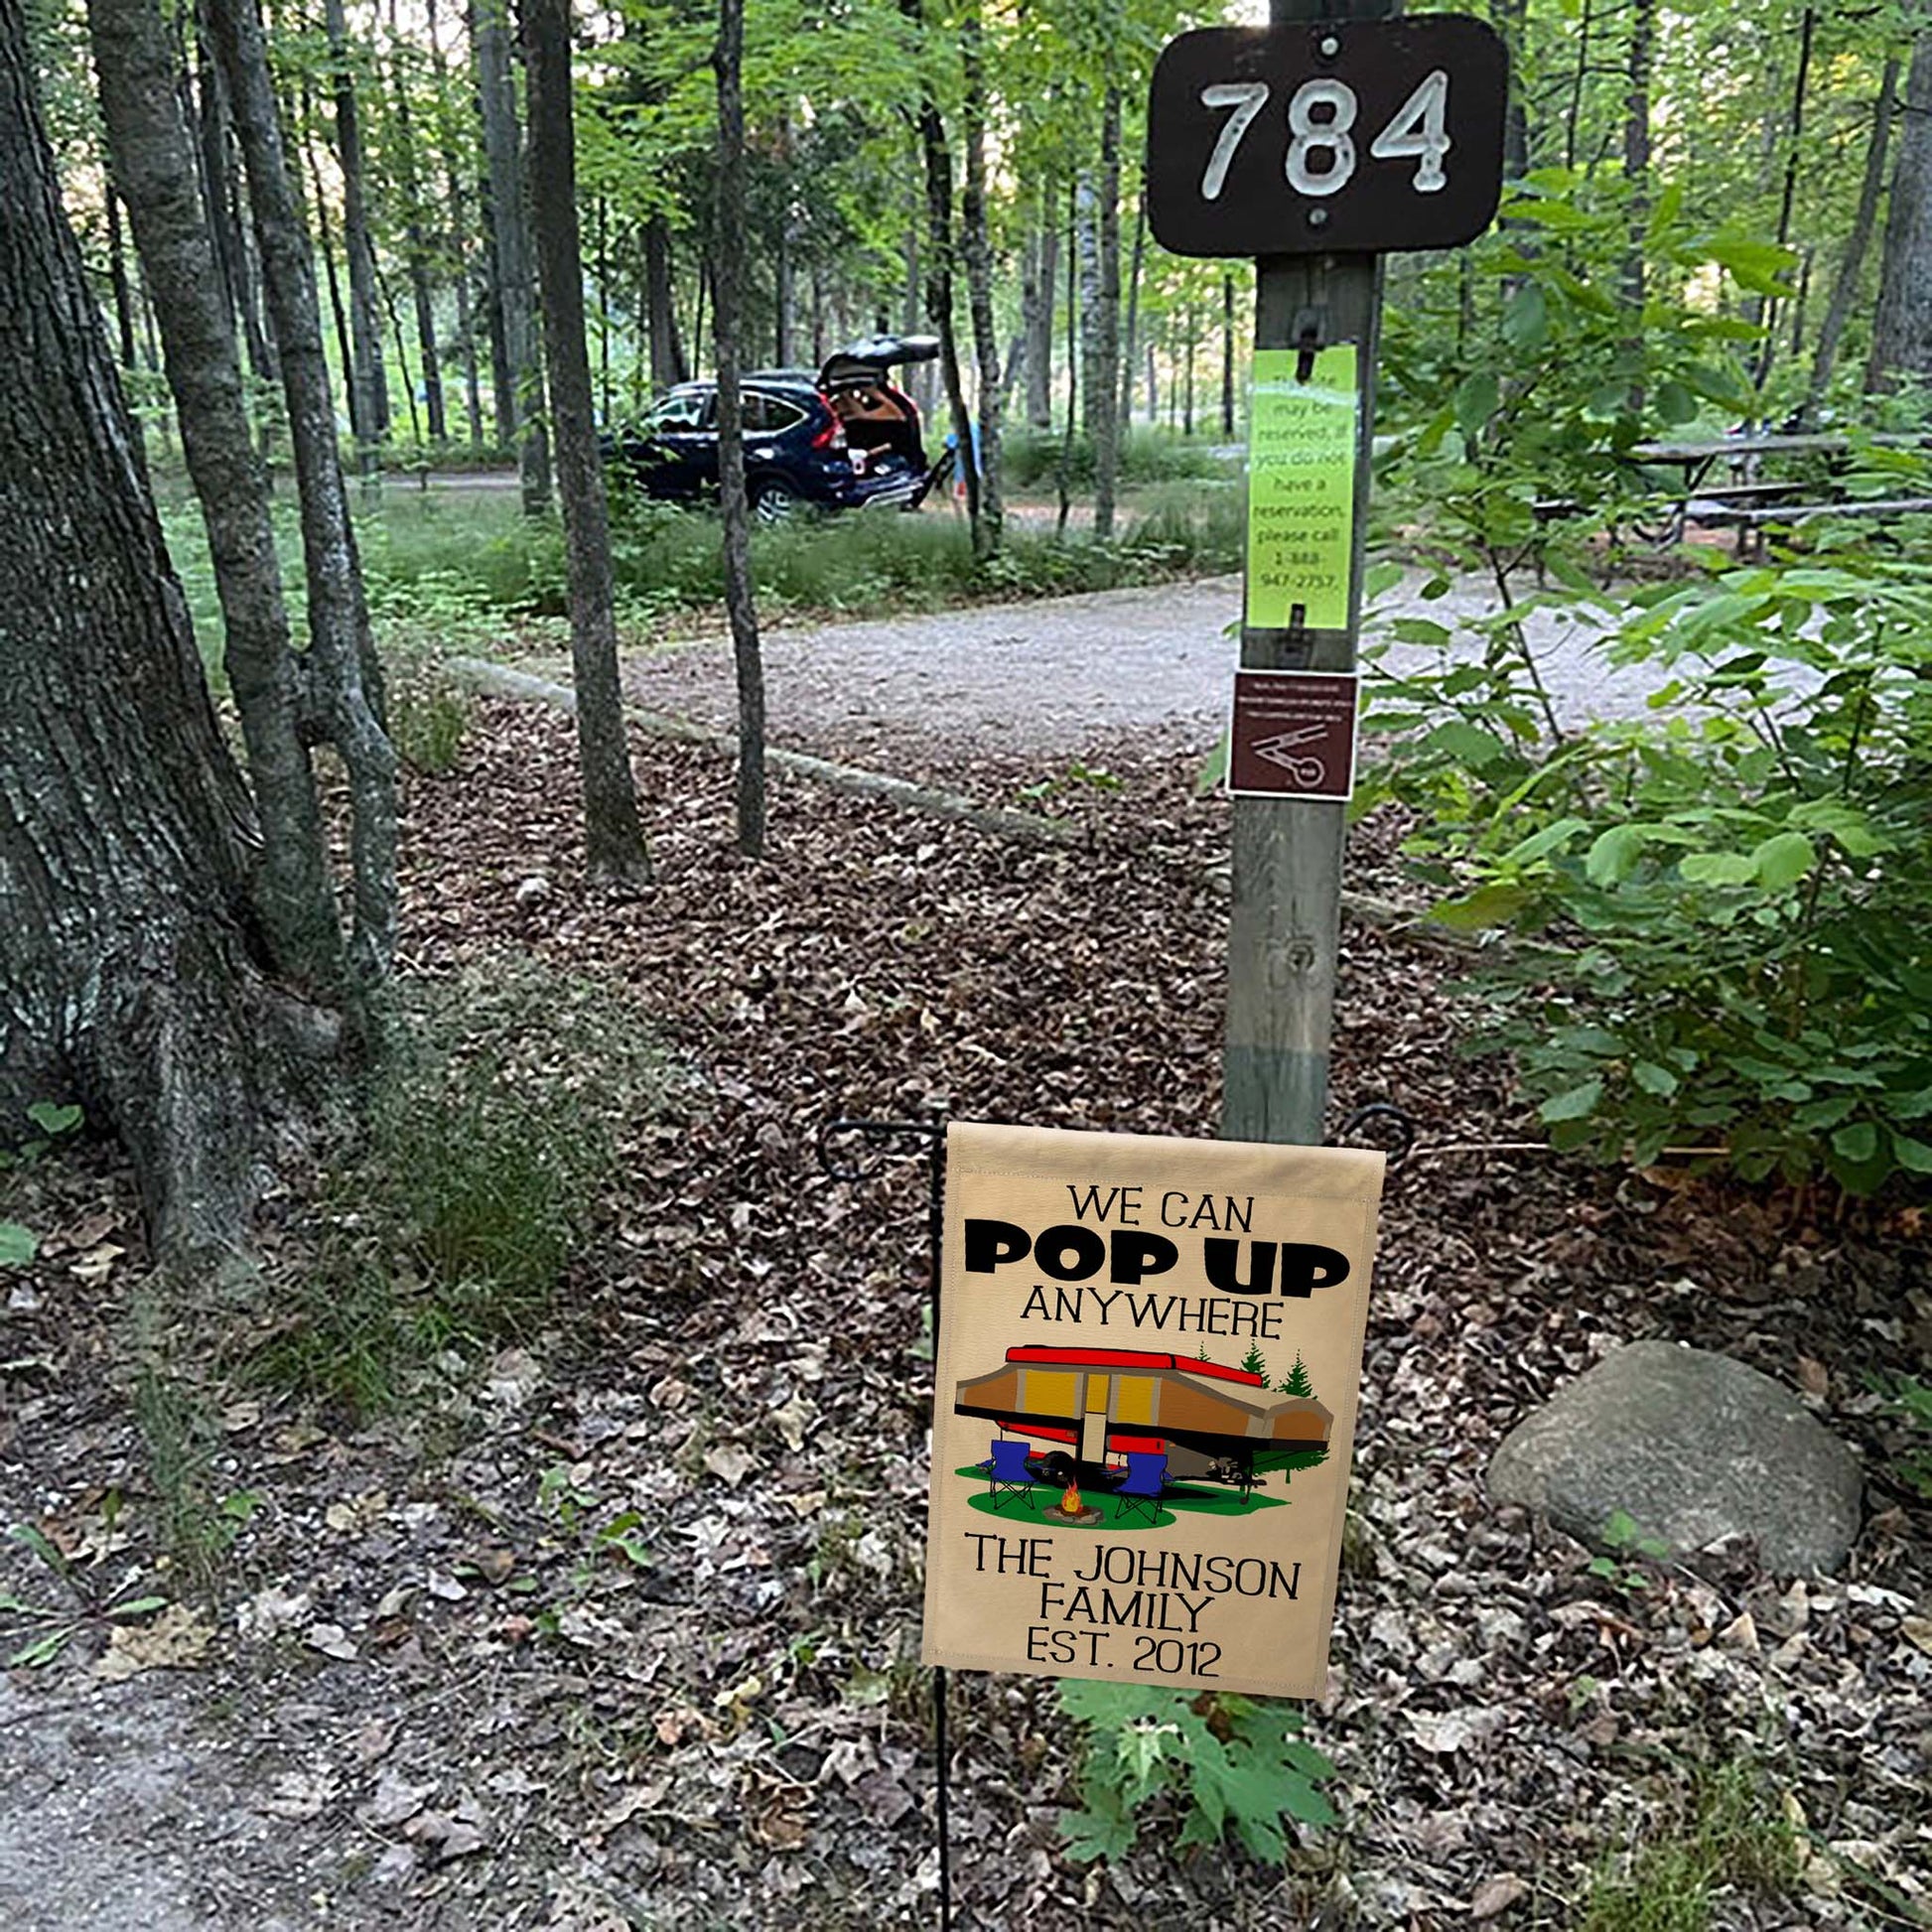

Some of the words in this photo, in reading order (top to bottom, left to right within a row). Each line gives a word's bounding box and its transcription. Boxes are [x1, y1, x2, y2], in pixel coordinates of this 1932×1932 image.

[1200, 69, 1451, 201] 784
[1255, 454, 1288, 471] you
[1292, 451, 1313, 467] do
[1316, 451, 1345, 467] not
[1274, 478, 1311, 492] have
[1316, 480, 1326, 491] a
[1258, 528, 1307, 544] please
[1311, 527, 1339, 542] call
[1066, 1184, 1143, 1226] WE
[1161, 1191, 1255, 1233] CAN
[964, 1218, 1178, 1285] POP
[1204, 1237, 1350, 1299] UP
[1020, 1286, 1284, 1340] ANYWHERE
[964, 1532, 1053, 1579] THE
[1073, 1545, 1302, 1600] JOHNSON
[1039, 1582, 1216, 1633] FAMILY
[1027, 1626, 1114, 1668] EST.
[1133, 1636, 1222, 1678] 2012
